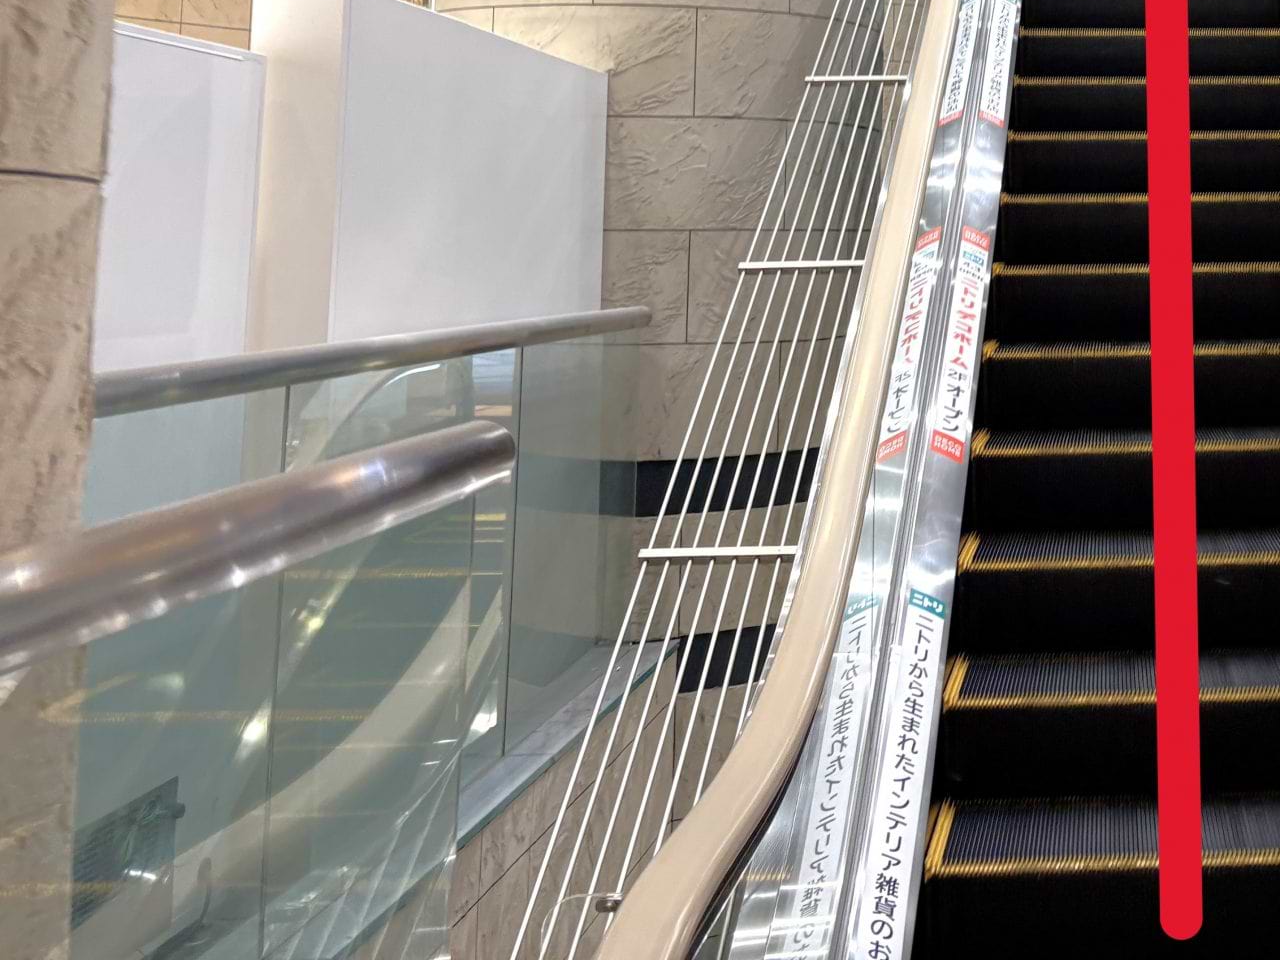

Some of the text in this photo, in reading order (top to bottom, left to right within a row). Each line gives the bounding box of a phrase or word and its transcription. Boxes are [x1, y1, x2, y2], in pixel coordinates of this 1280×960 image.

[949, 278, 980, 370] ニトリデコホーム
[942, 384, 966, 433] オープン
[911, 593, 944, 614] ニトリ
[868, 614, 936, 960] ニトリから生まれたインテリア雑貨のお
